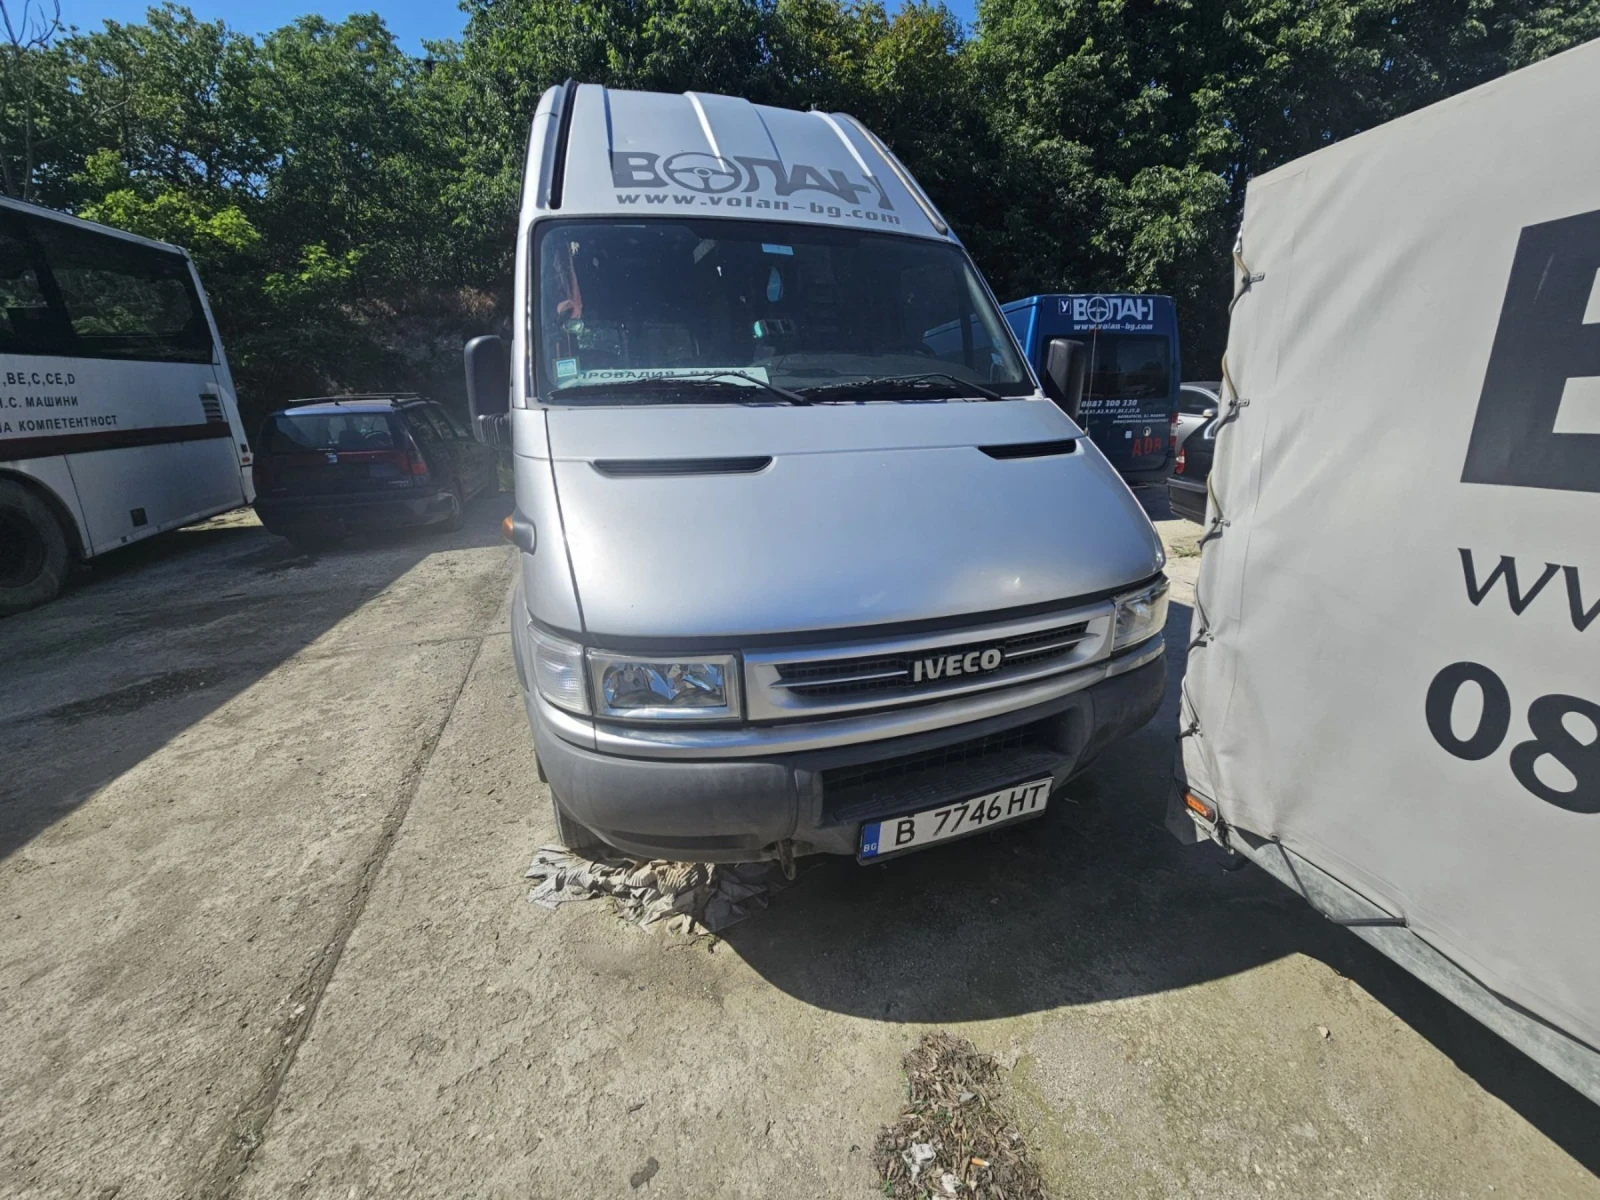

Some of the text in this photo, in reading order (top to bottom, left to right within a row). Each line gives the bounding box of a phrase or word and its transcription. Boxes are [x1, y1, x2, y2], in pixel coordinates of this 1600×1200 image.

[616, 193, 901, 225] www.volan-bg.com
[1073, 322, 1153, 331] www.volan-bg.com
[25, 395, 79, 408] МАШИНИ
[18, 415, 117, 431] КОМПЕТЕНТНОСТ
[1133, 438, 1161, 456] ADR
[913, 648, 1001, 683] IVECO
[863, 843, 877, 852] BG
[932, 795, 1003, 837] 7746
[1006, 783, 1047, 816] HT
